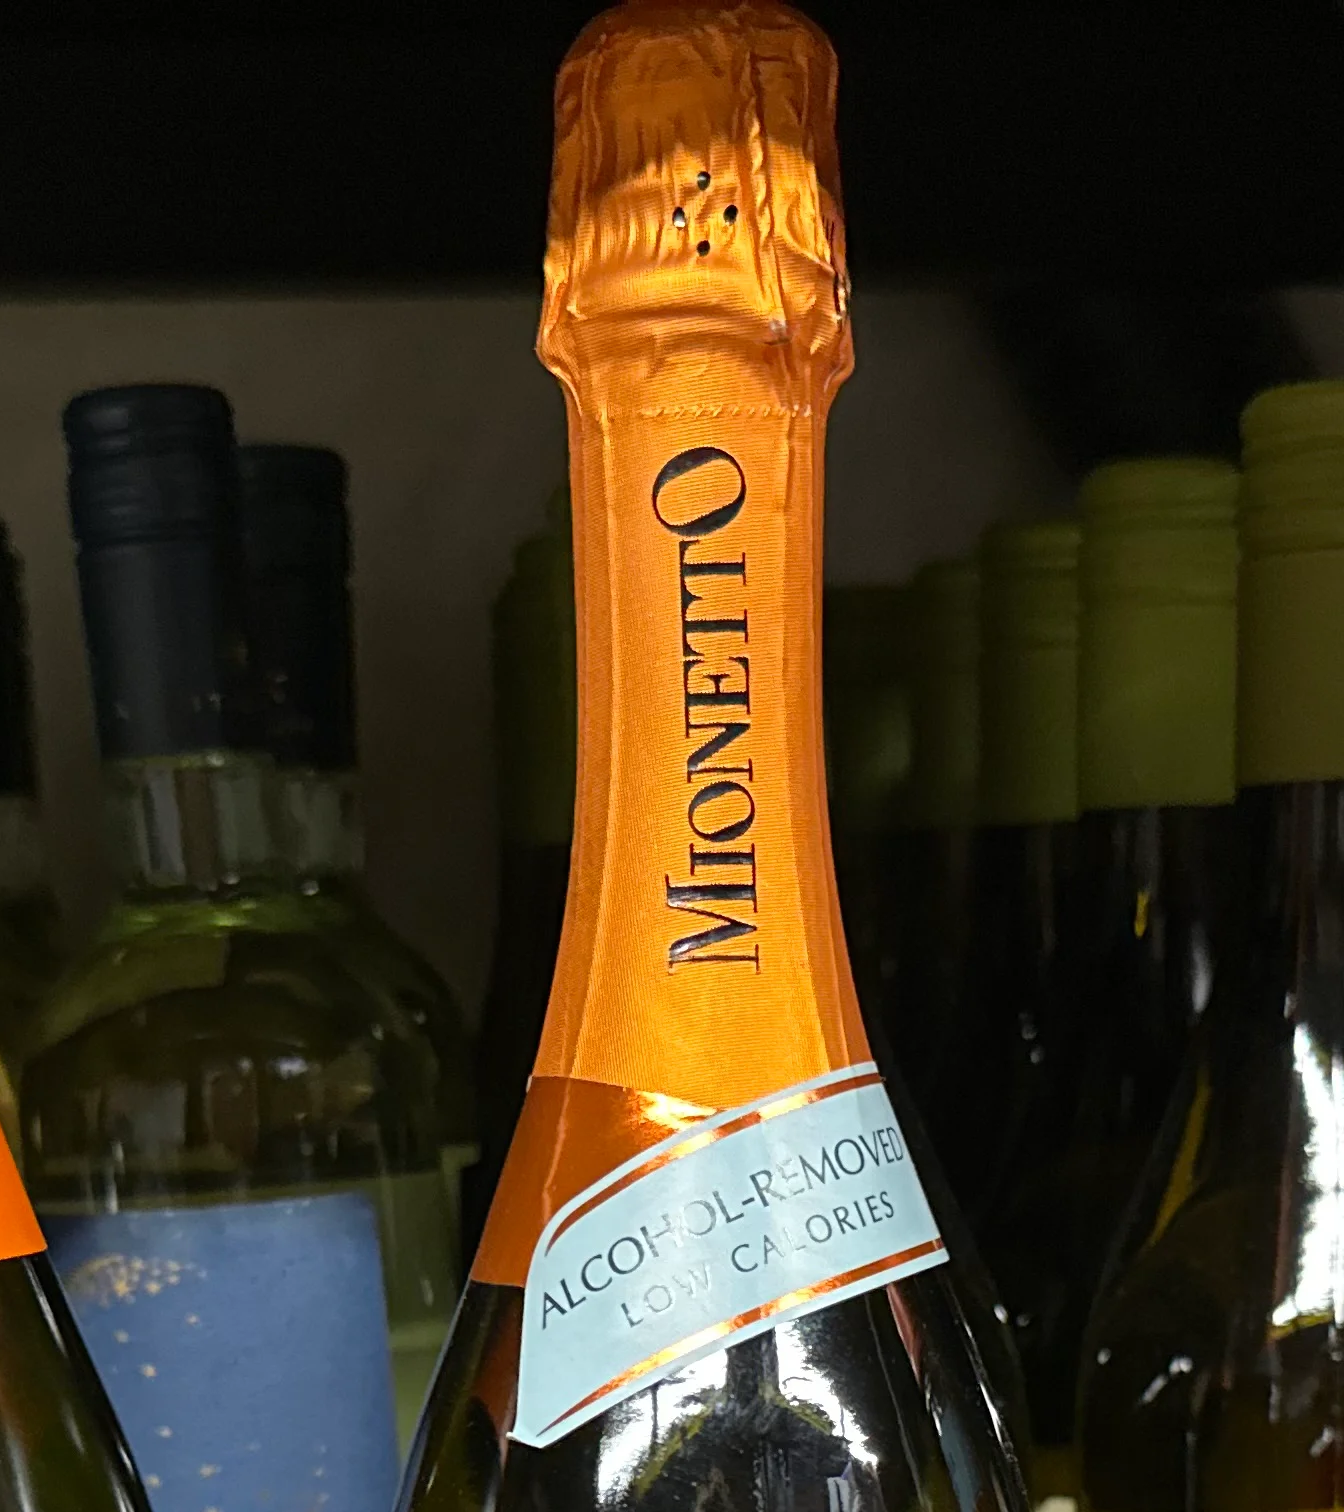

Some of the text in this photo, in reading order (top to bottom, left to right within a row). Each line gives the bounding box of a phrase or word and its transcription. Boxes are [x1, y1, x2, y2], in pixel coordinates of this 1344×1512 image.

[652, 446, 760, 974] MIONETTO
[539, 1125, 905, 1329] ALCOHOL-REMOVED
[620, 1191, 895, 1328] LOW CALORIES
